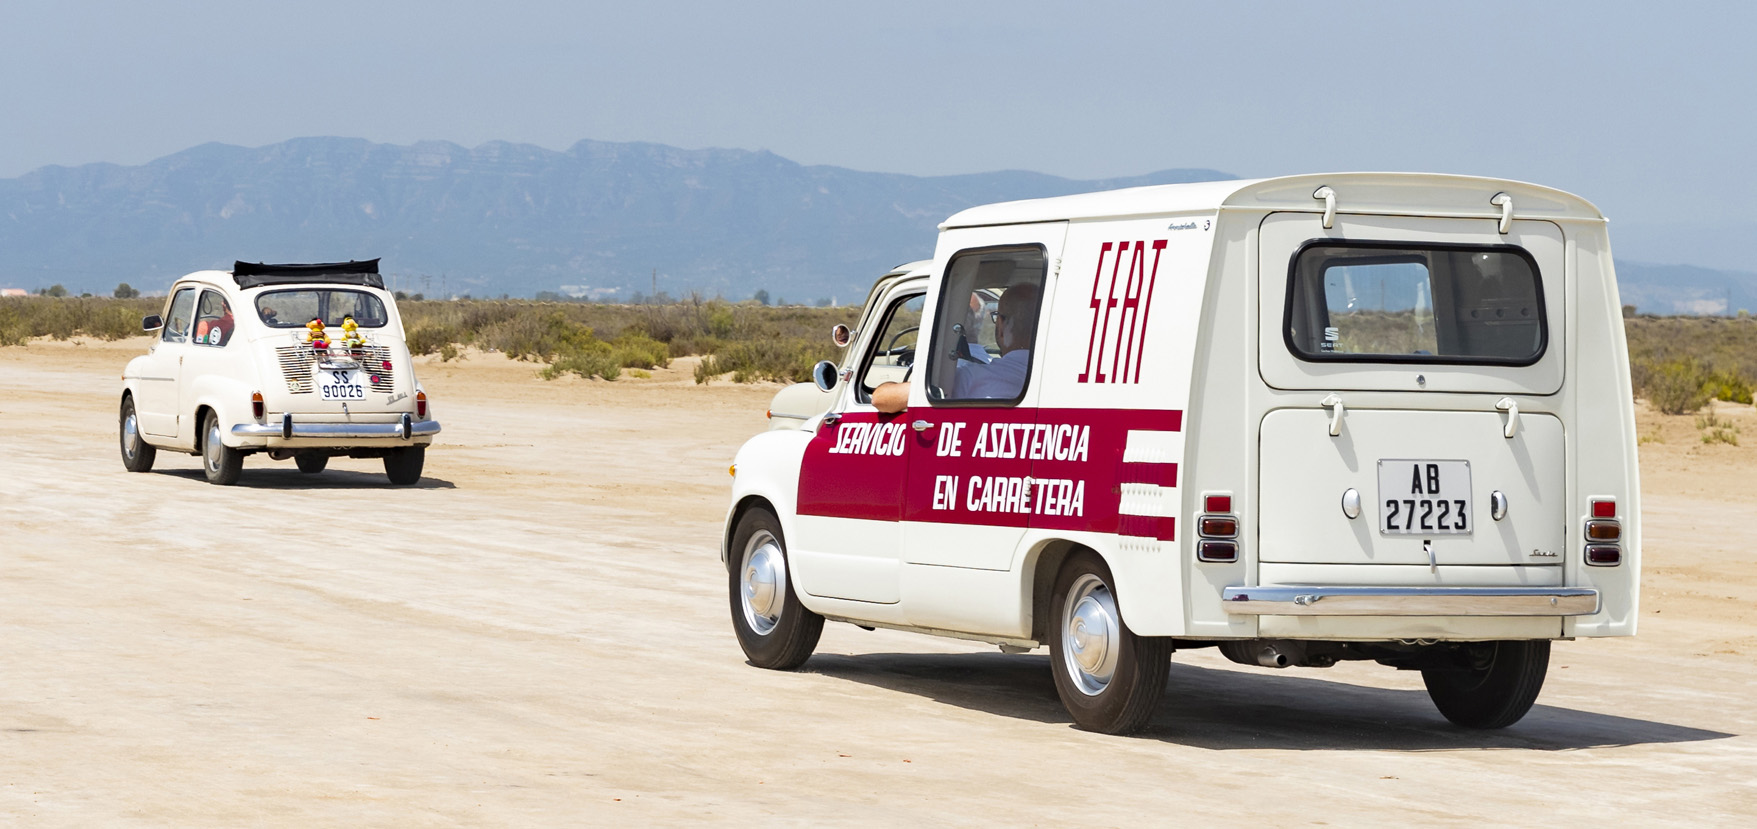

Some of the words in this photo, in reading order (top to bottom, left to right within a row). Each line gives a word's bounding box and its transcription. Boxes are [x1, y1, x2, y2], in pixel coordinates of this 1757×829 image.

[1077, 239, 1168, 384] SEAT
[323, 385, 363, 398] 90026
[332, 371, 349, 384] SS
[828, 422, 907, 456] SERVICIO
[936, 422, 966, 457] DE
[972, 422, 1090, 462] ASISTENCIA
[1411, 463, 1440, 495] AB
[932, 475, 959, 510] EN
[966, 475, 1085, 517] CARRETERA
[1386, 499, 1467, 530] 27223
